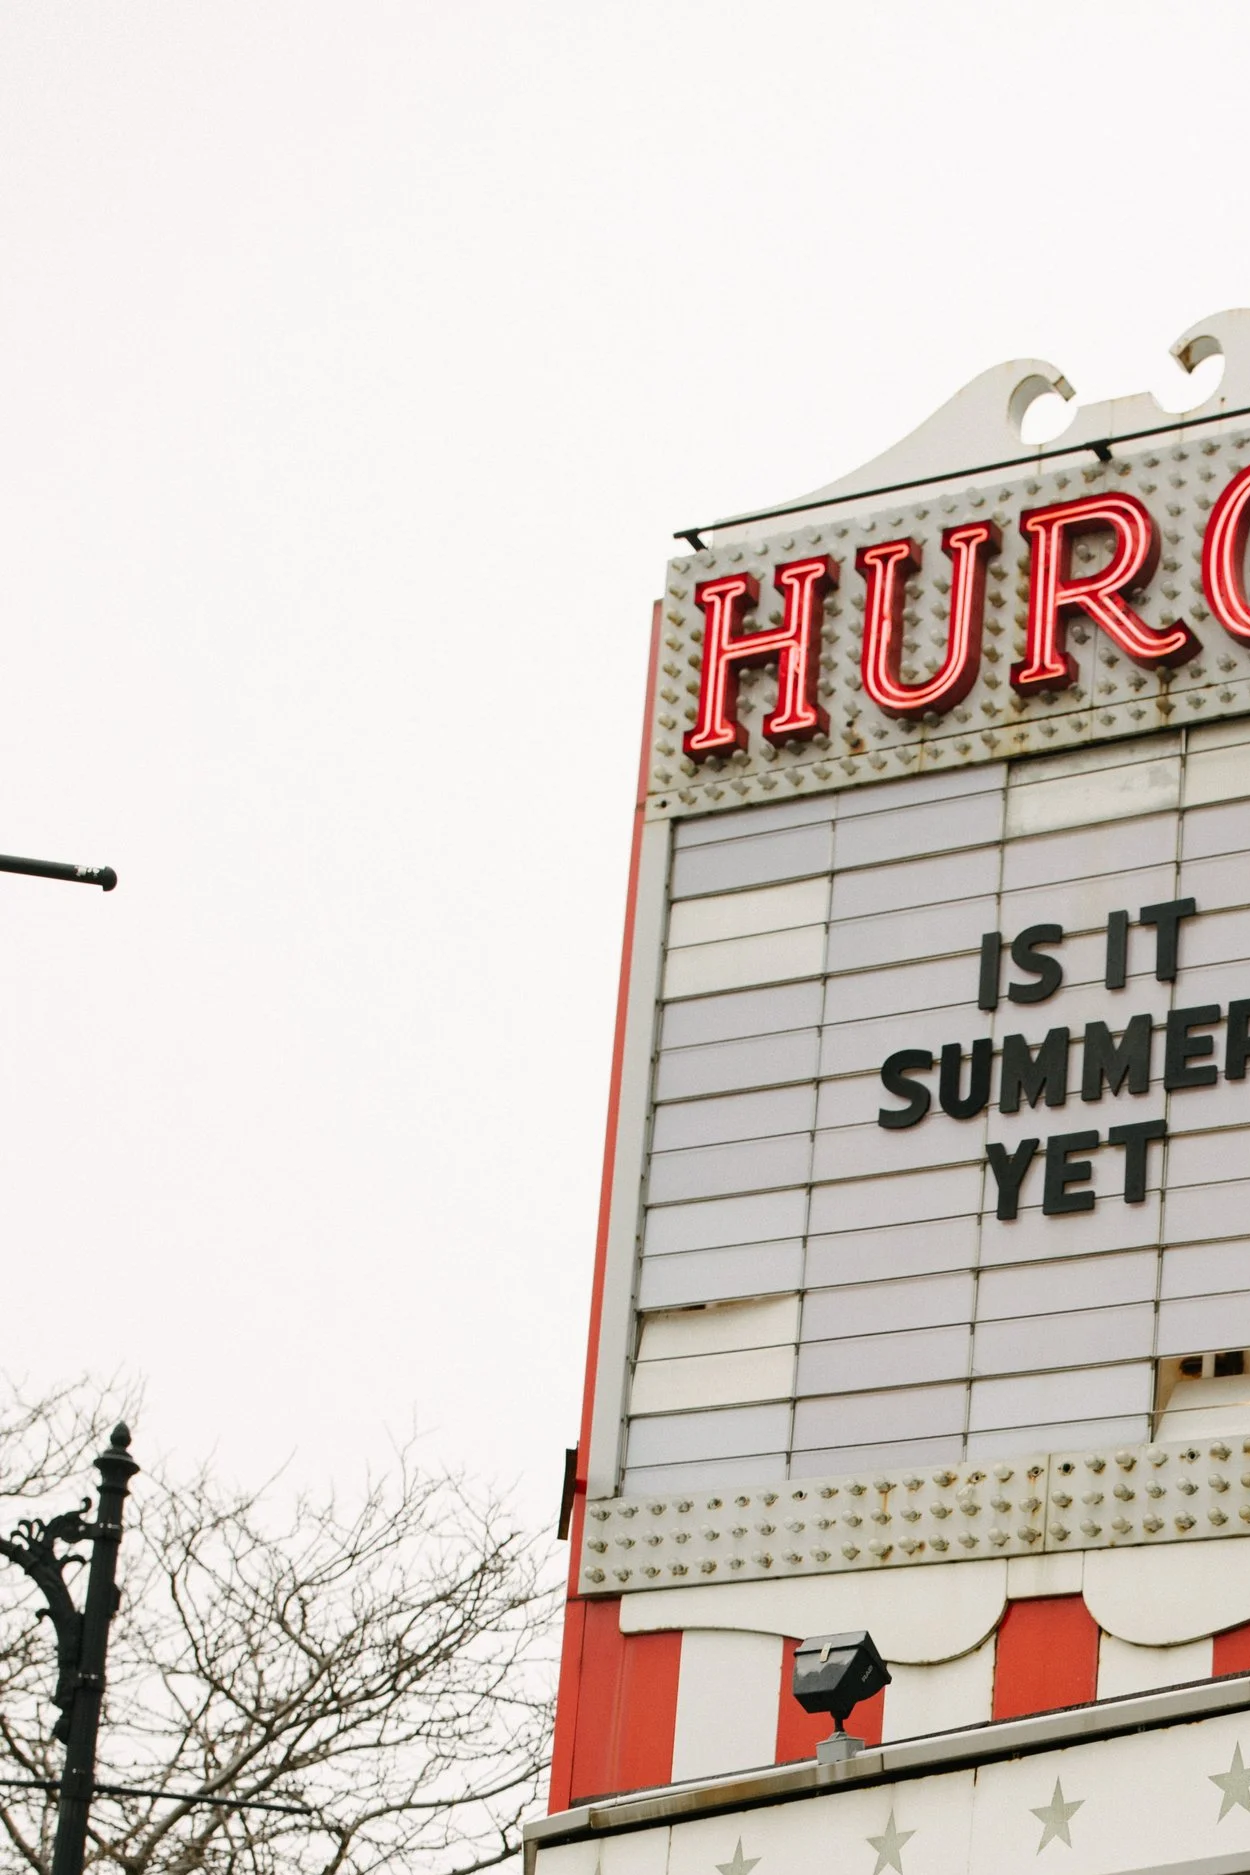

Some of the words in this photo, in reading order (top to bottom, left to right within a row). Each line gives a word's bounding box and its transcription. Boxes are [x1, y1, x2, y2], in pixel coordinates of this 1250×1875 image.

[978, 923, 1064, 1010] IS
[1105, 897, 1197, 990] IT
[985, 1119, 1168, 1221] YET
